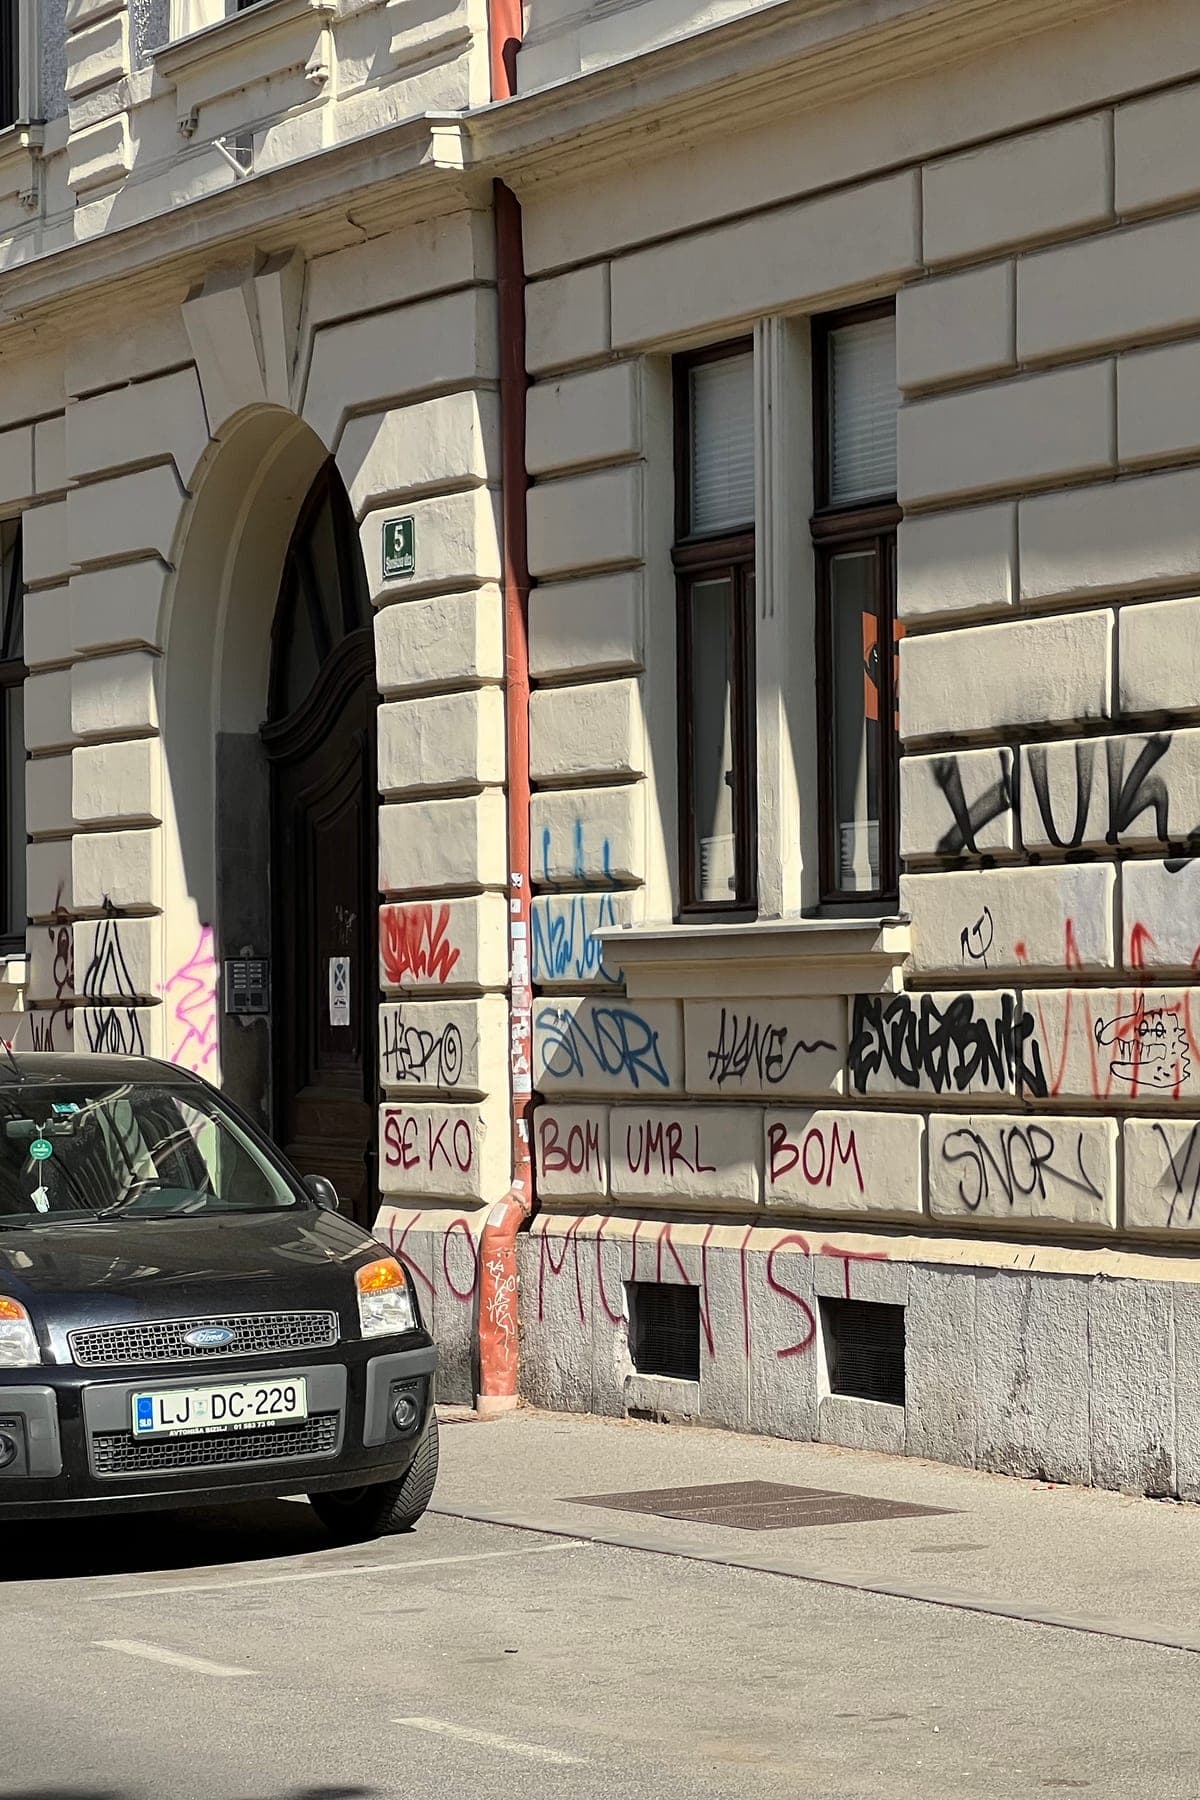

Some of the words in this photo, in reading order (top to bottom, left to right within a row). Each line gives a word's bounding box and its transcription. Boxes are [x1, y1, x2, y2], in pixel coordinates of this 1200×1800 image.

[394, 524, 404, 552] 5
[540, 1118, 602, 1182] BOM
[626, 1119, 716, 1177] UMRL
[768, 1121, 864, 1192] BOM
[196, 1330, 224, 1342] Ford
[160, 1397, 190, 1425] LJ
[211, 1386, 296, 1420] DC-229
